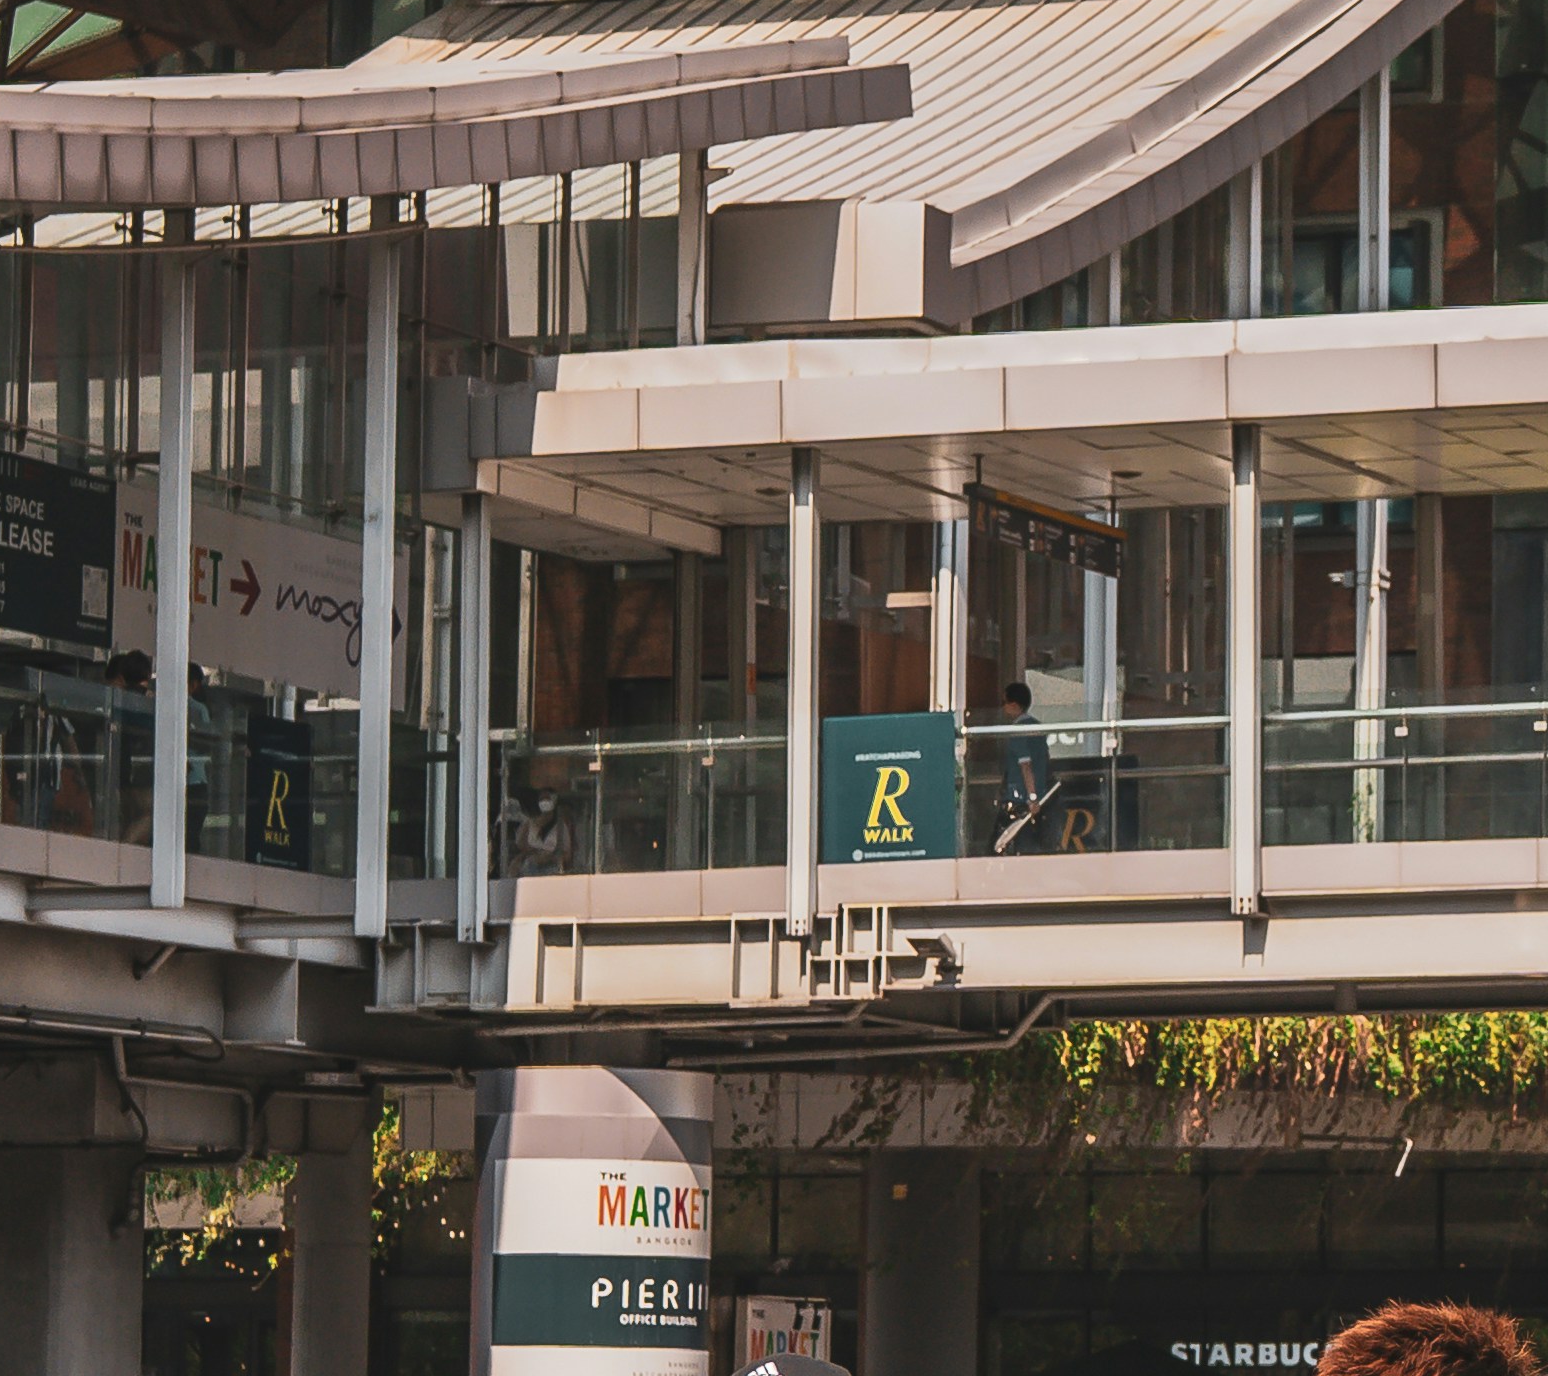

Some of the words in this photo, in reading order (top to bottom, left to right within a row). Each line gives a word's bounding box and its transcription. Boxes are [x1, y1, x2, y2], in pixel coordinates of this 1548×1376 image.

[6, 494, 45, 521] SPACE
[122, 529, 223, 608] MAET
[267, 769, 290, 829] R
[867, 766, 912, 827] R
[863, 827, 914, 844] WALK
[1060, 808, 1095, 853] R
[600, 1171, 627, 1181] THE
[598, 1185, 710, 1232] MARKET
[636, 1236, 692, 1246] BANGKOK
[591, 1277, 679, 1310] PIER
[619, 1313, 657, 1325] OFFICE
[1171, 1341, 1333, 1367] STARBUC
